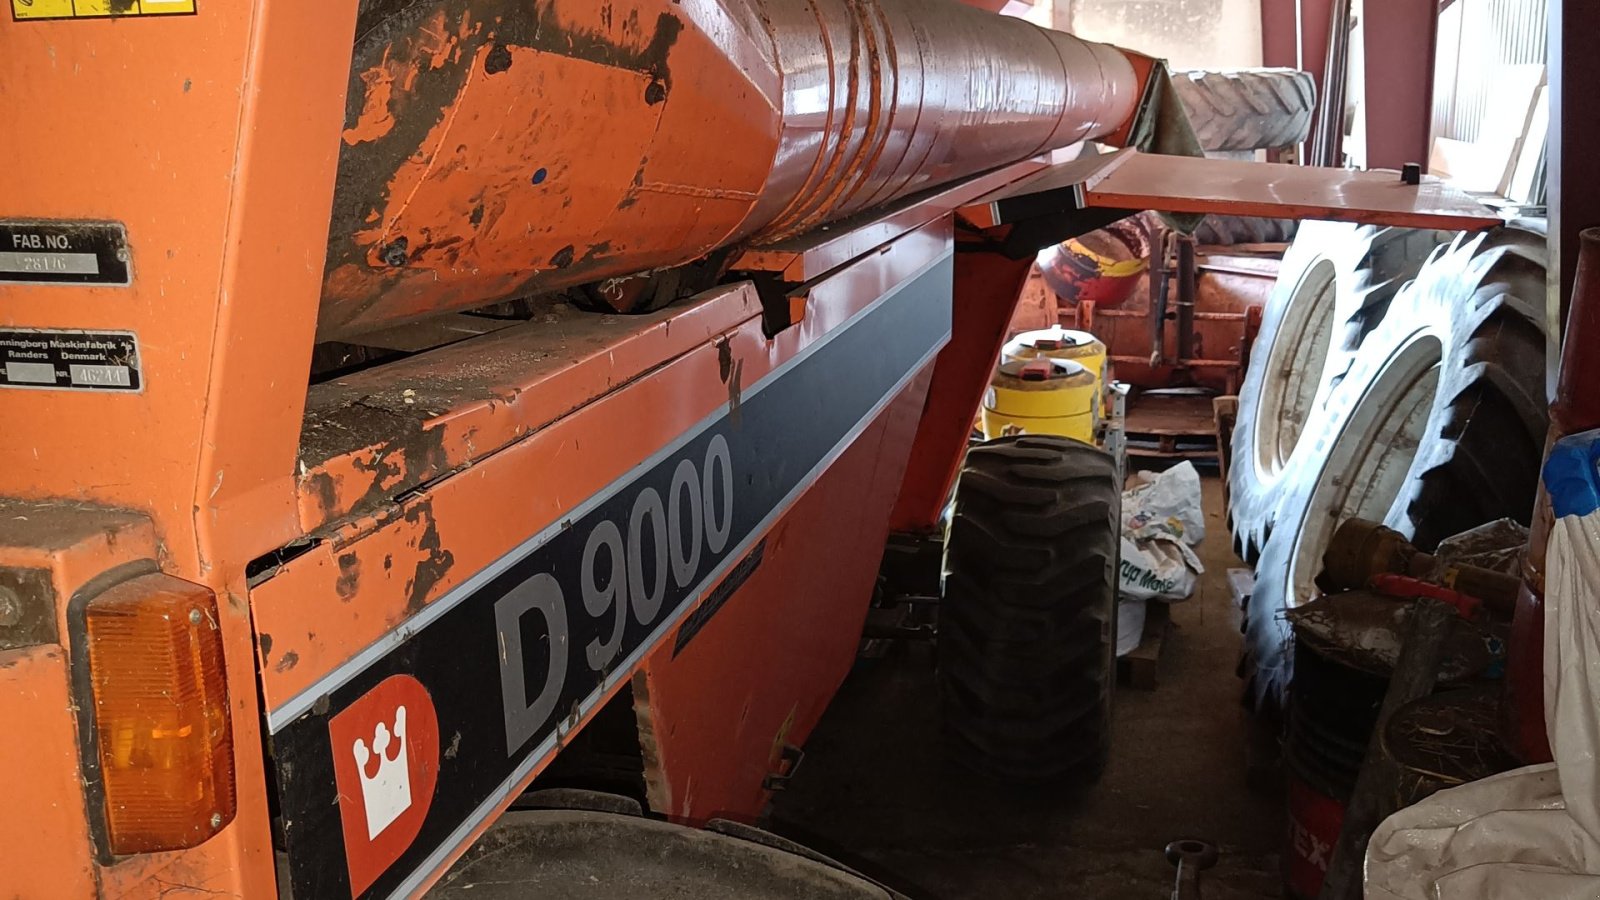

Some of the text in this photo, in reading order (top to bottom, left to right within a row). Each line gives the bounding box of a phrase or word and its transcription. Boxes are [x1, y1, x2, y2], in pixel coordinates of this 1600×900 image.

[12, 234, 72, 249] FAB. NO.
[50, 340, 117, 350] Maskinfabrik
[8, 350, 107, 361] Randers Denmark
[494, 433, 733, 758] D 9000
